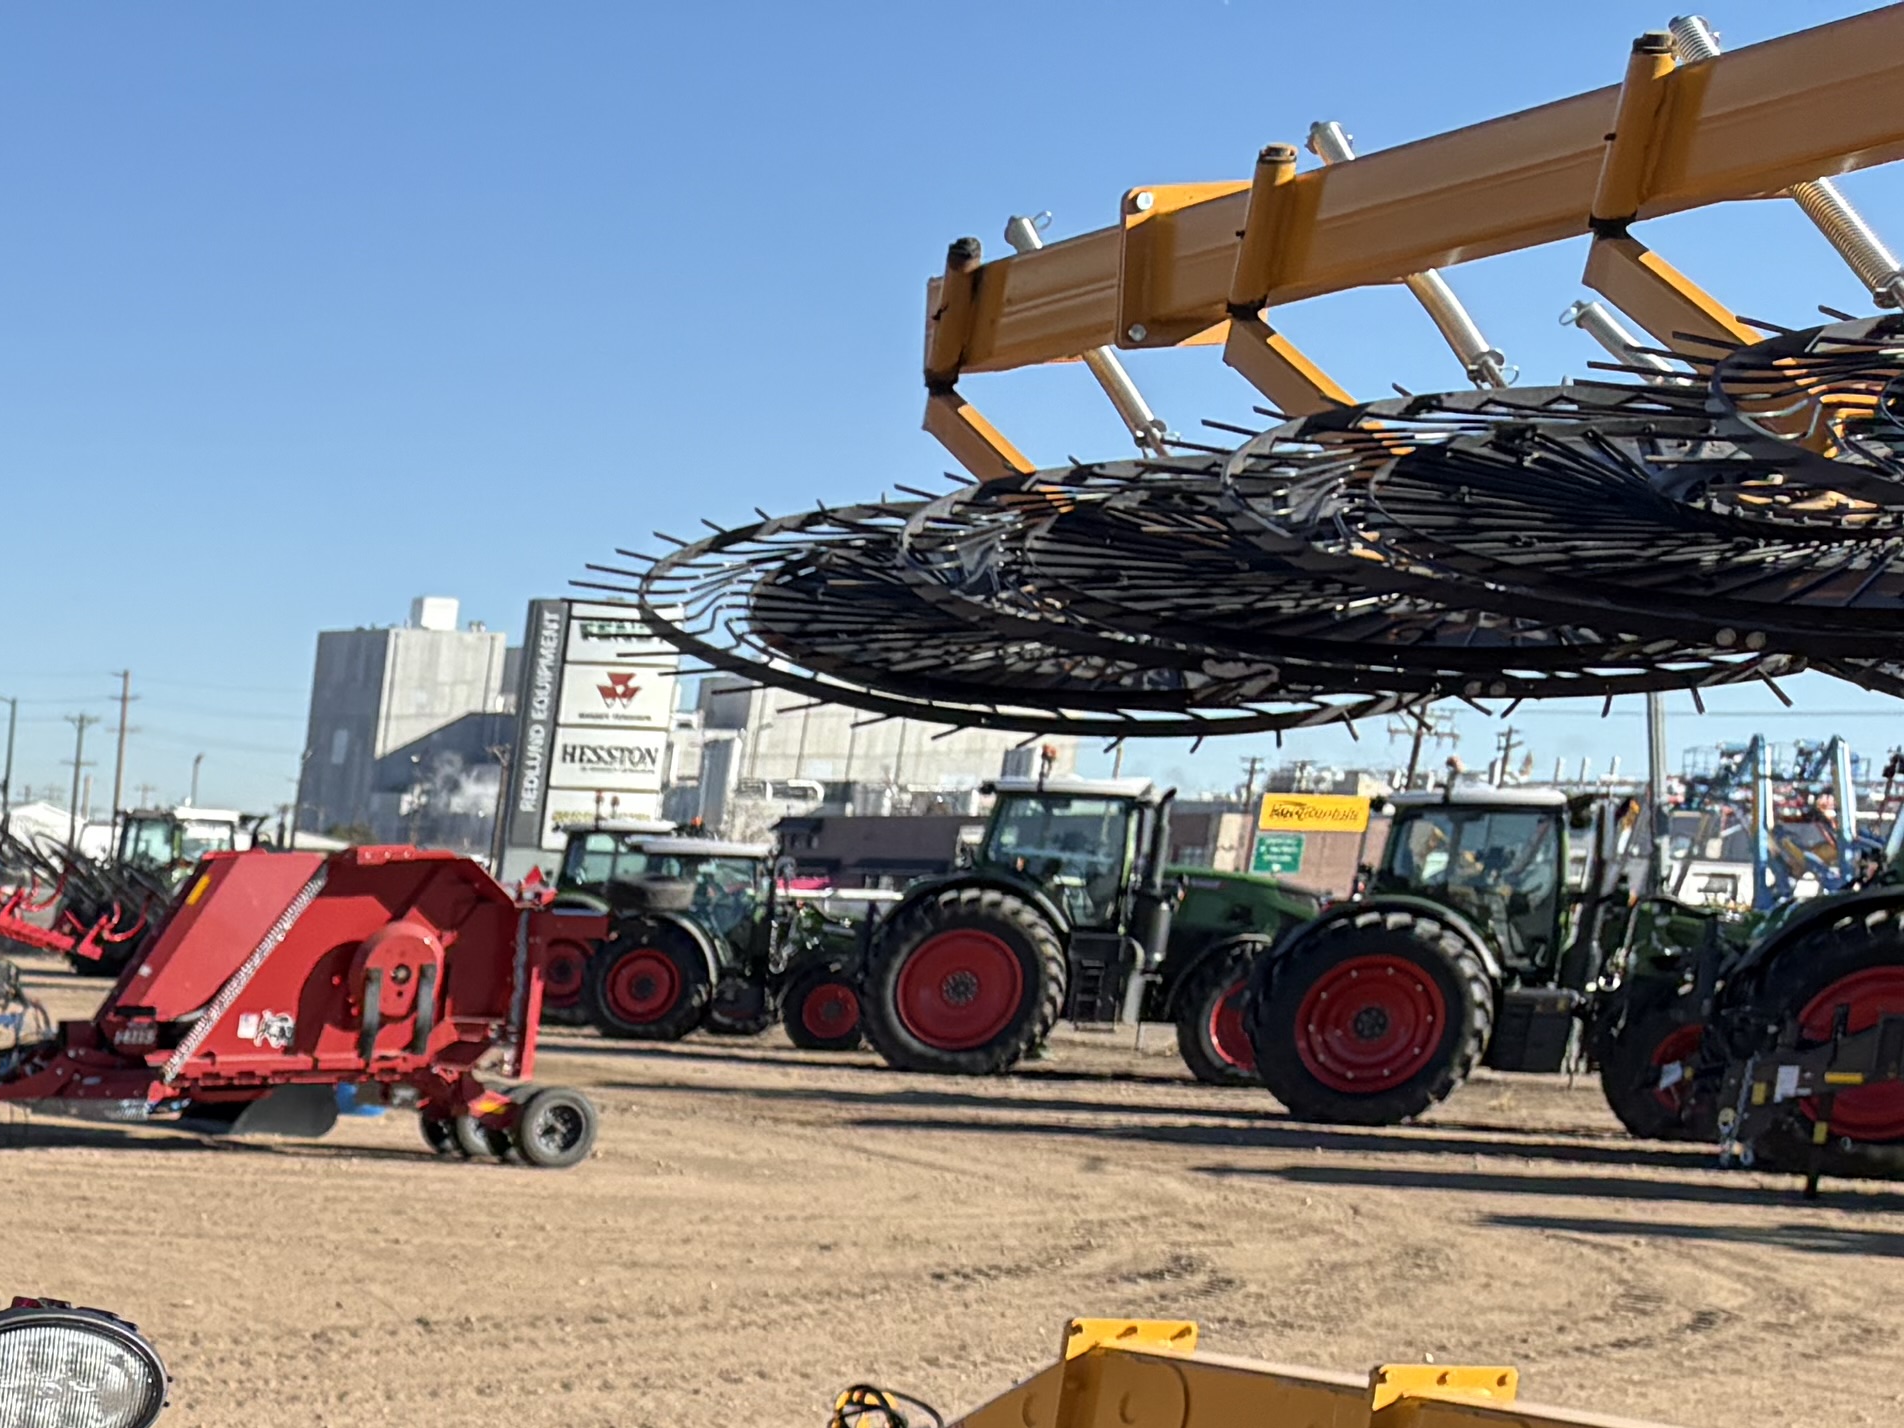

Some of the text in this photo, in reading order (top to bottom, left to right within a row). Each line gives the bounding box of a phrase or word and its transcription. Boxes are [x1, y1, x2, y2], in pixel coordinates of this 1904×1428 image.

[520, 611, 561, 812] REDLUND EQUIPMENT
[561, 744, 659, 769] HESSTON
